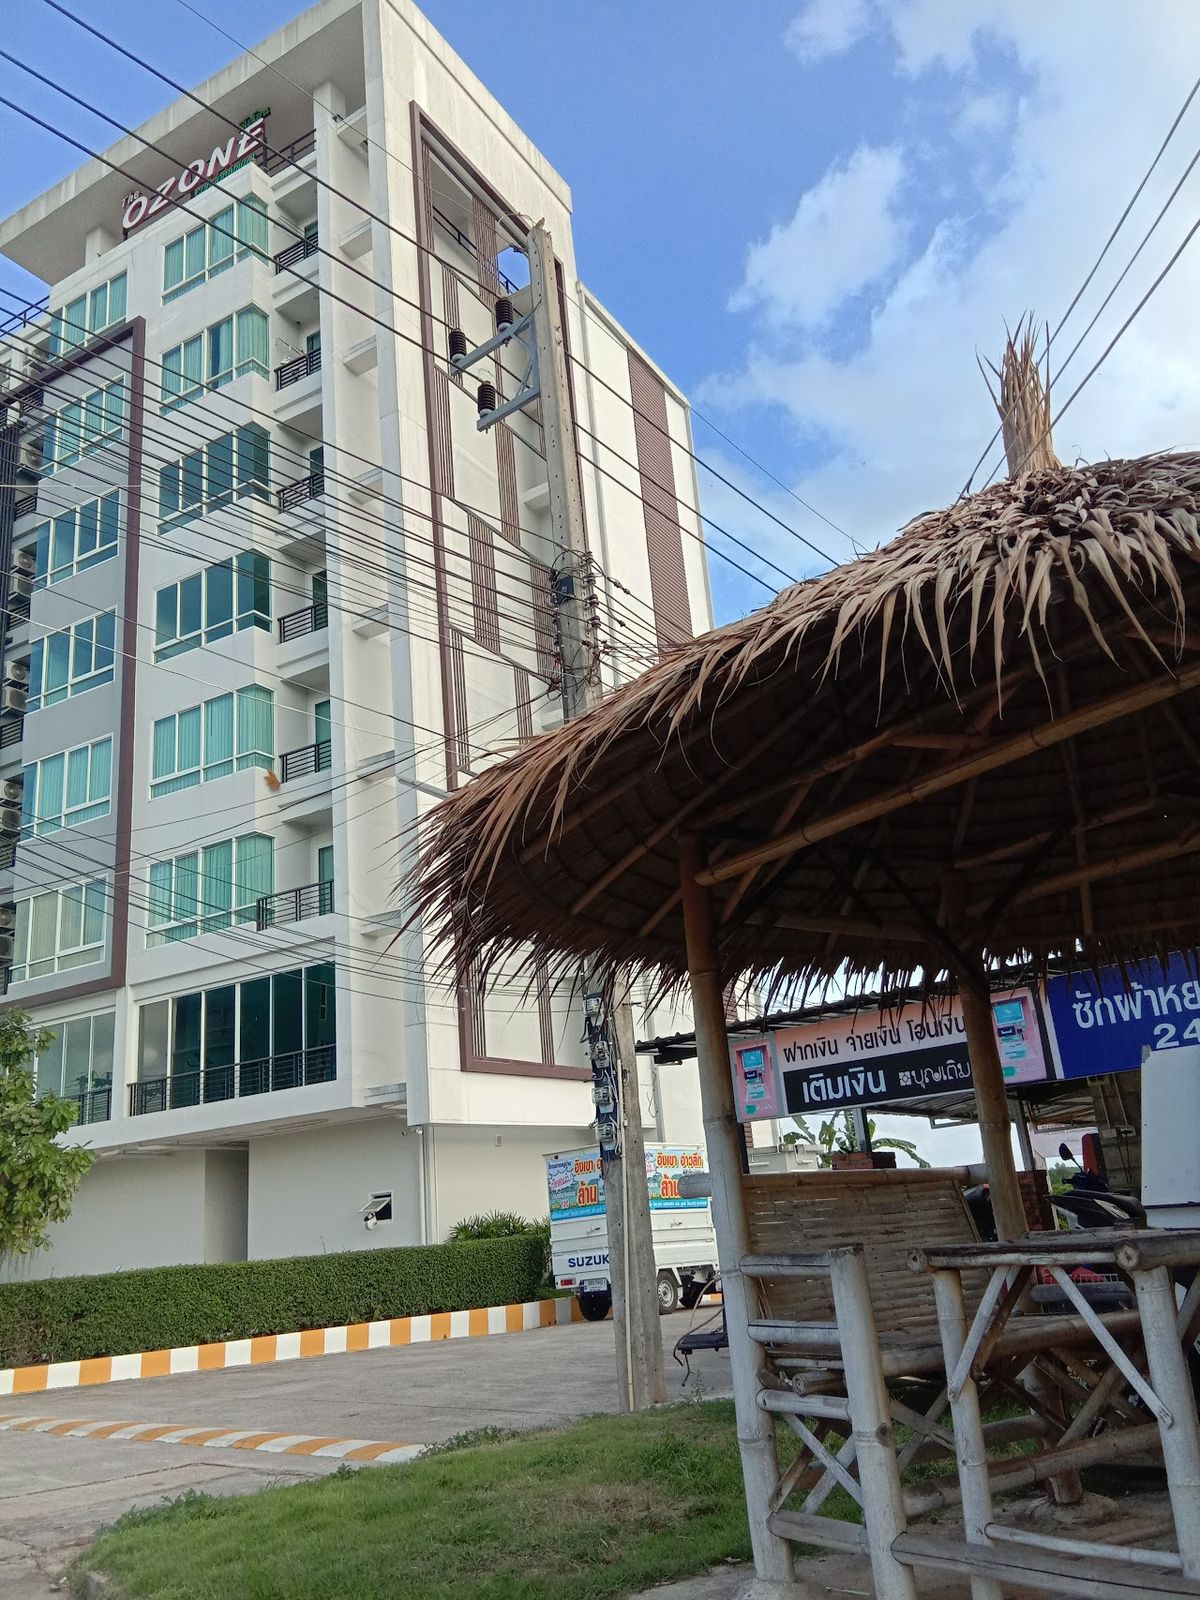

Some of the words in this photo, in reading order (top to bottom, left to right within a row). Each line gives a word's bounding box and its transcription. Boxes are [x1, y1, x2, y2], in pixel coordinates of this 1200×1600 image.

[122, 117, 265, 229] OZONE
[783, 1037, 839, 1064] ฝากเงิน
[846, 1025, 901, 1052] จ่ายเงิน
[908, 1013, 967, 1042] โอนเงิน
[802, 1066, 887, 1104] เติมเงิน
